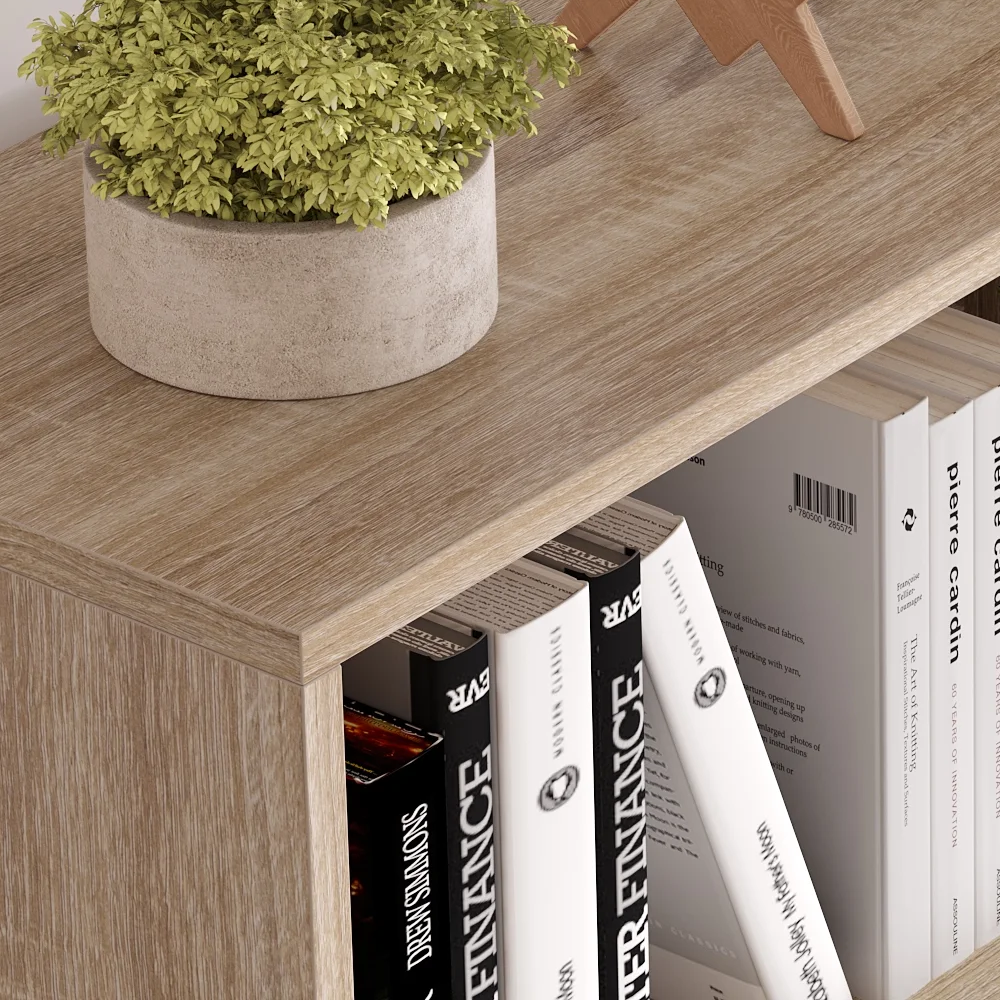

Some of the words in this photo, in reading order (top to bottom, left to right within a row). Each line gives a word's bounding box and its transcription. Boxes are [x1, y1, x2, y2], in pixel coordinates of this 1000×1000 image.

[788, 505, 793, 513] 9
[798, 508, 823, 524] 780500
[828, 519, 853, 535] 285572
[947, 461, 961, 555] pierre
[600, 583, 642, 630] EVR
[949, 566, 962, 665] cardin
[734, 612, 741, 620] of
[742, 615, 766, 629] stitches
[767, 625, 780, 635] and
[781, 628, 805, 644] fabrics,
[739, 648, 767, 666] working
[768, 658, 782, 670] with
[784, 665, 801, 677] yarn,
[995, 654, 1000, 670] 60
[446, 667, 490, 713] EVR
[768, 692, 795, 710] opening
[796, 703, 806, 713] up
[911, 694, 918, 709] of
[951, 683, 957, 698] 60
[752, 696, 778, 715] knitting
[779, 708, 804, 722] designs
[769, 736, 807, 757] instructions
[790, 734, 812, 749] photos
[909, 711, 918, 772] Knitting
[951, 748, 958, 765] OF
[786, 767, 794, 775] or
[611, 659, 648, 917] FINANCE
[401, 802, 431, 908] SIMMONS
[756, 820, 776, 861] Moon
[458, 744, 498, 1000] FINANCE
[405, 902, 432, 970] DREW
[788, 916, 812, 963] Jolley
